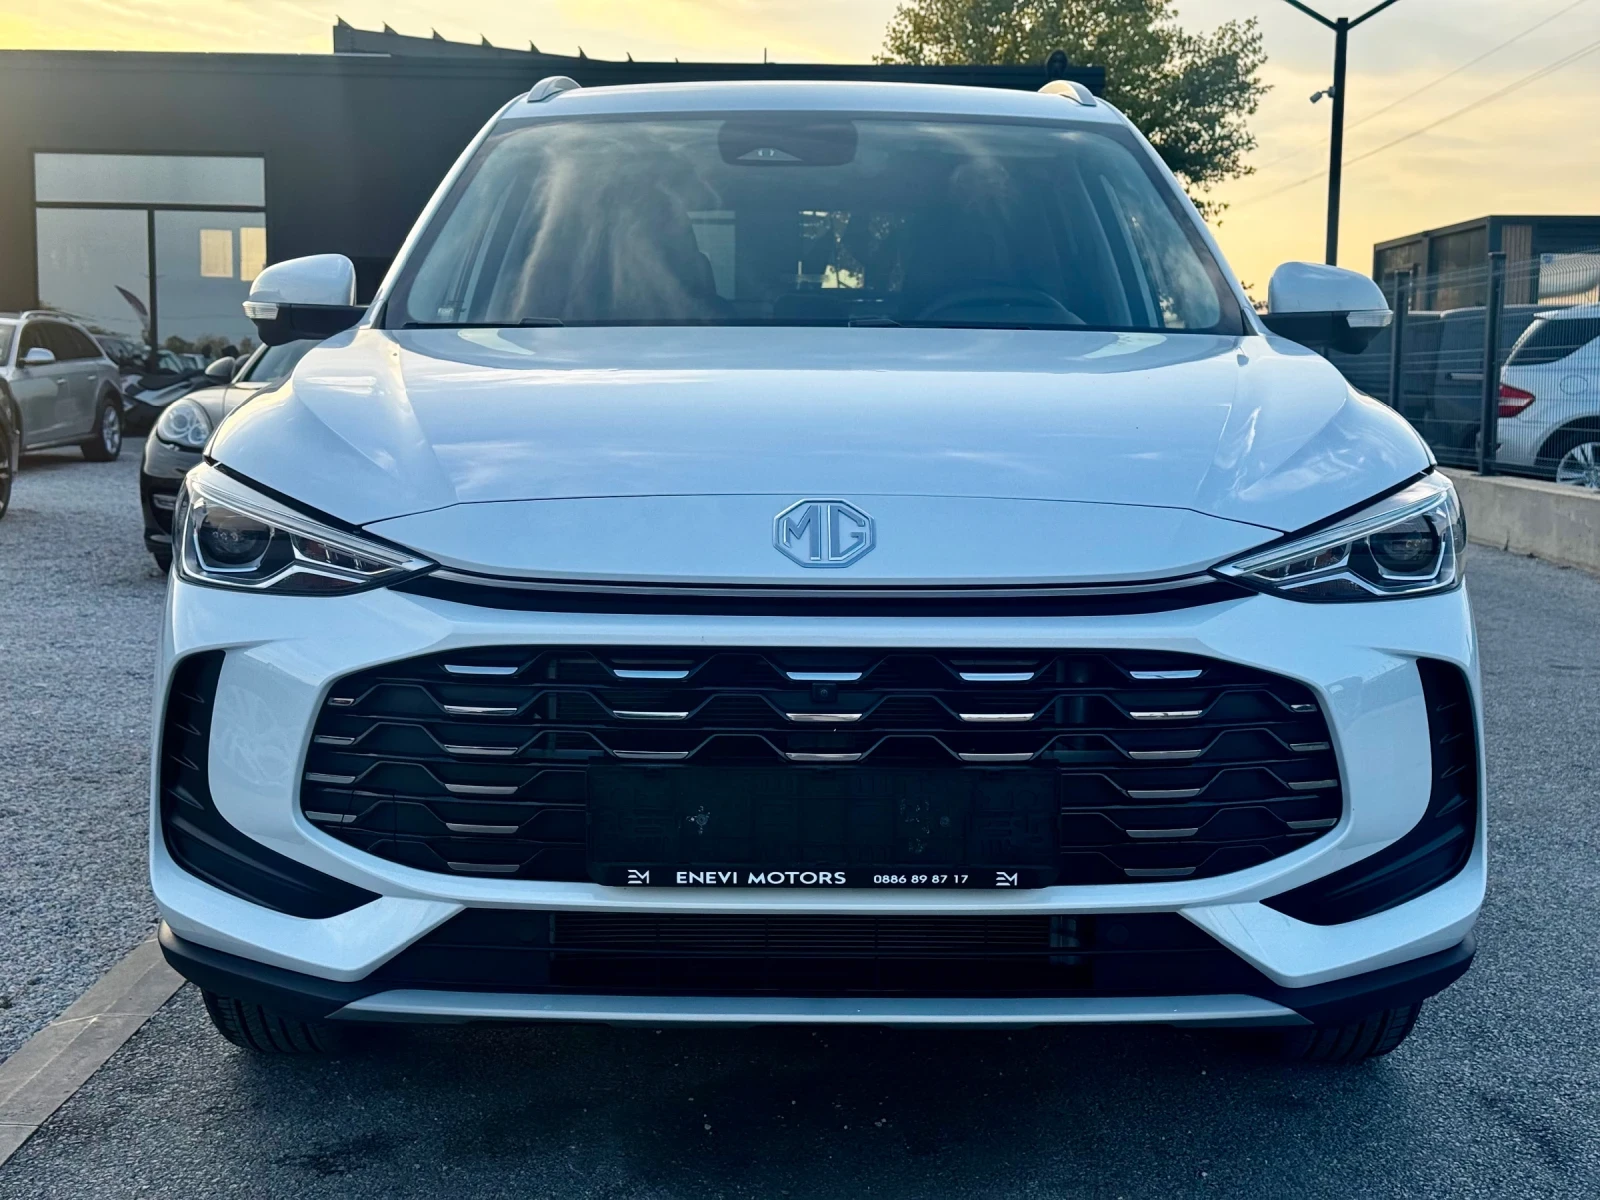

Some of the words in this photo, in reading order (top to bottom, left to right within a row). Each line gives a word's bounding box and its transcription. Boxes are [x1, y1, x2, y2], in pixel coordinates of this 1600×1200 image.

[781, 503, 867, 562] MG
[676, 871, 738, 885] ENEVI
[747, 871, 847, 885] MOTORS
[873, 874, 907, 884] 0886
[910, 874, 928, 884] 89
[931, 874, 948, 884] 87
[953, 874, 969, 884] 17
